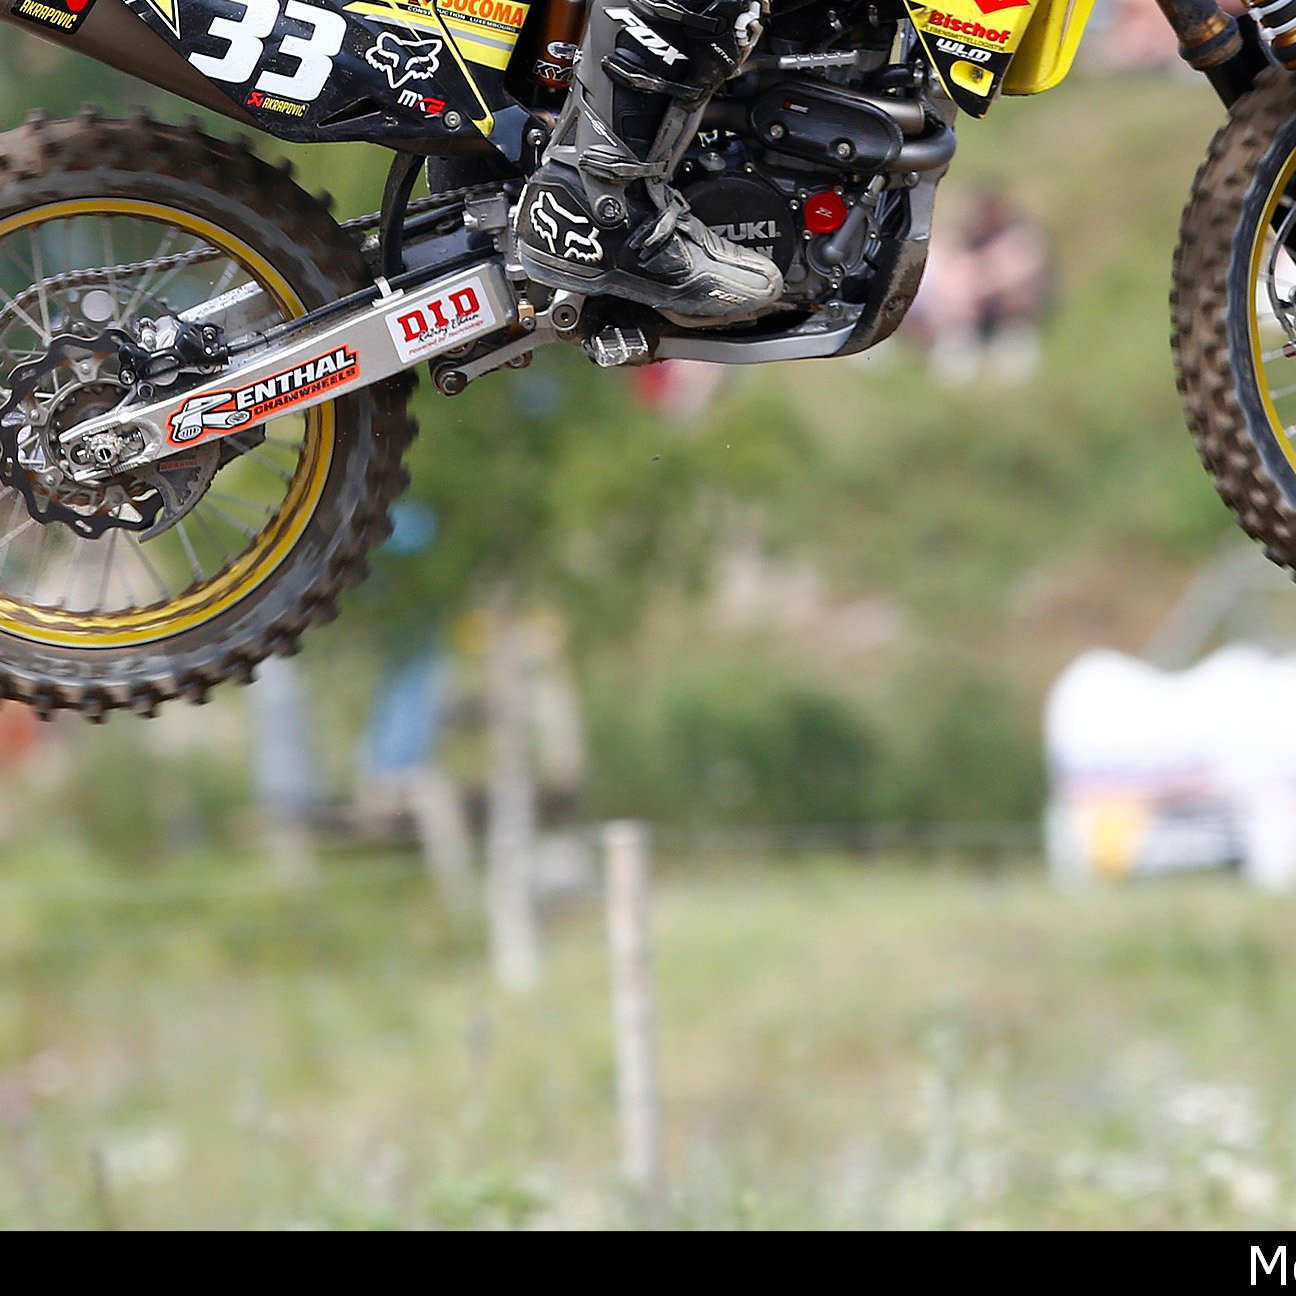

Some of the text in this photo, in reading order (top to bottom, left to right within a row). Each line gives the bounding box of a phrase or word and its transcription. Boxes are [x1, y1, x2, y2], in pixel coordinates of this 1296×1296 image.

[407, 6, 466, 20] CONSTUCTION
[929, 10, 1012, 44] Bischof
[602, 6, 689, 66] FOX
[253, 368, 356, 415] CHAINWHEELS
